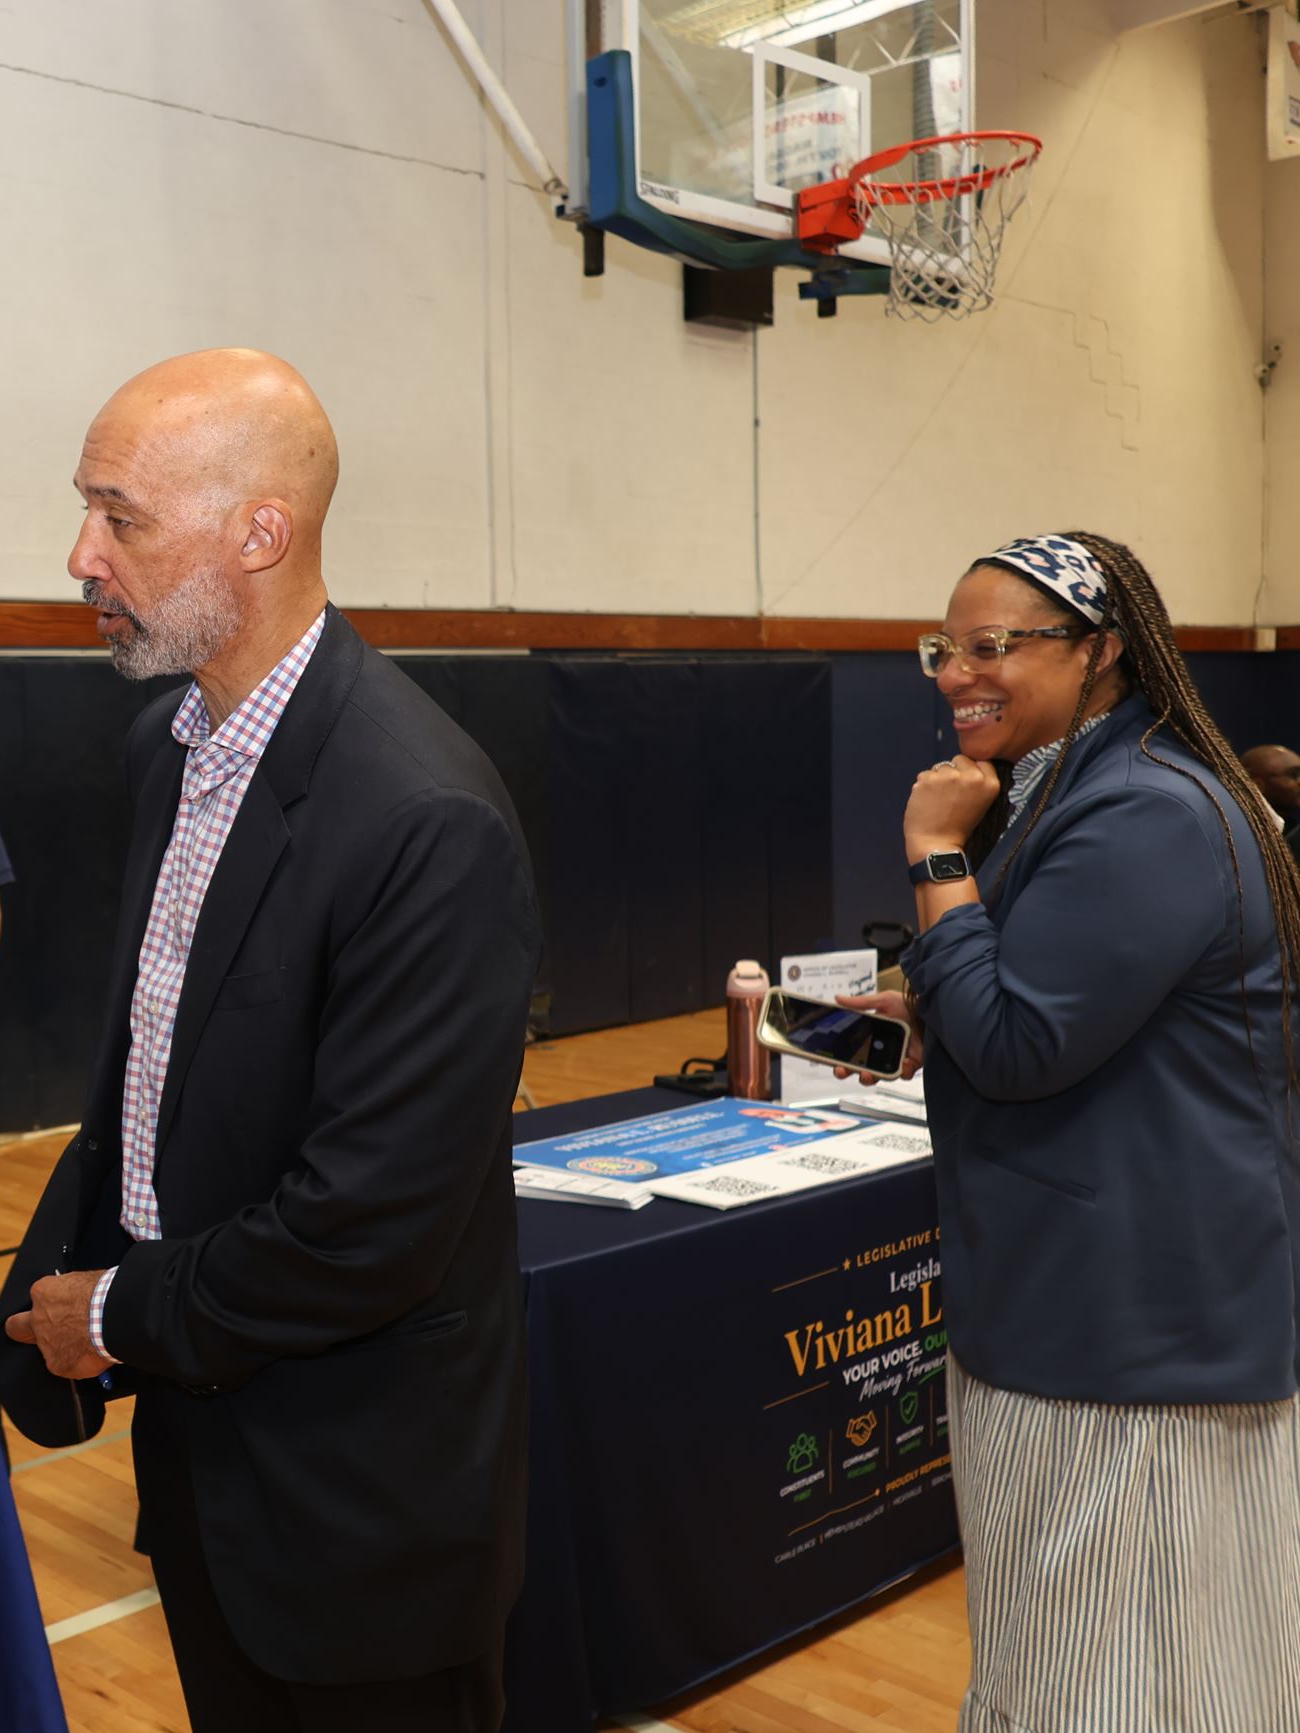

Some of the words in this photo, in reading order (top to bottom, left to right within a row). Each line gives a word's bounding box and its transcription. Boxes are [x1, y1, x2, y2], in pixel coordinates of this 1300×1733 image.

[856, 1229, 932, 1268] LEGISLATIVE
[889, 1257, 941, 1293] Legisla
[784, 1303, 912, 1377] Viviana
[842, 1356, 881, 1386] YOUR
[881, 1339, 923, 1370] VOICE.
[858, 1374, 904, 1402] Moving
[906, 1354, 948, 1382] Forwar
[780, 1469, 826, 1498] CONSTITUENTS
[886, 1466, 919, 1493] PROUDLY
